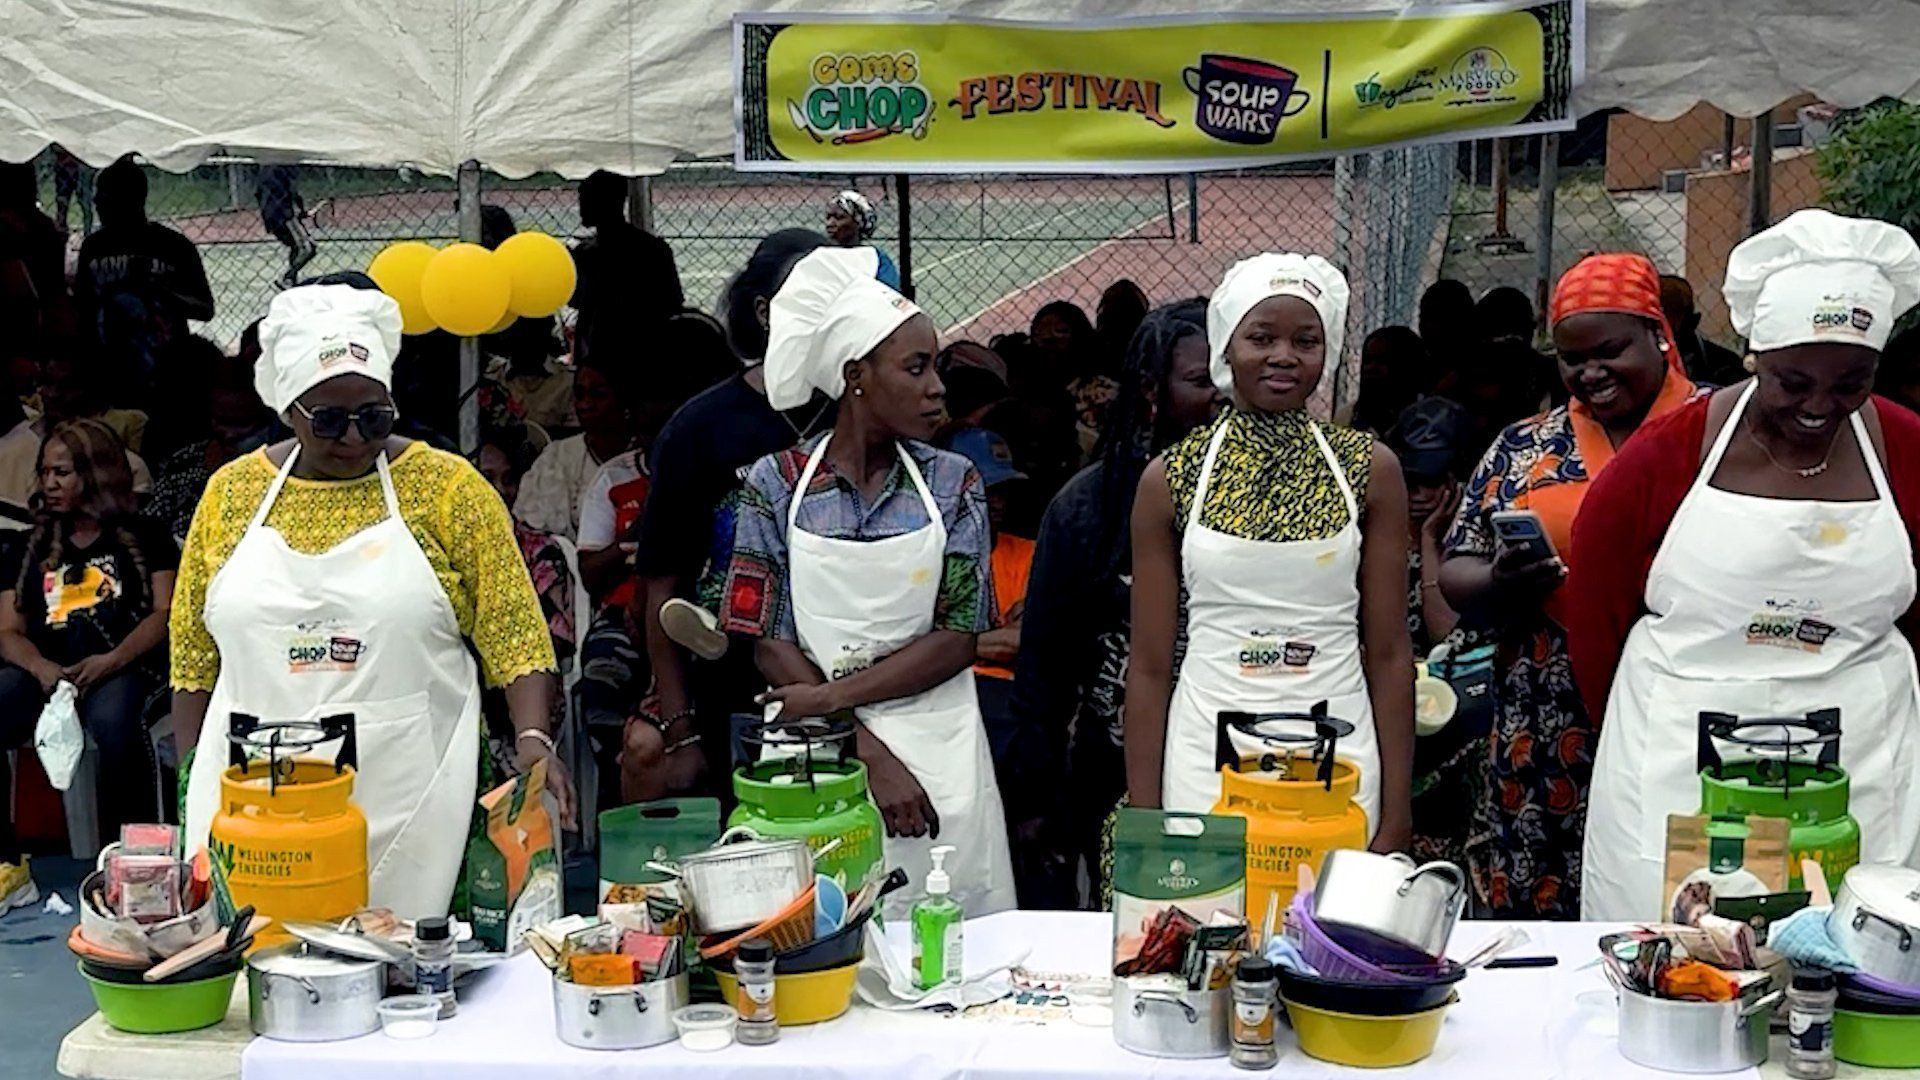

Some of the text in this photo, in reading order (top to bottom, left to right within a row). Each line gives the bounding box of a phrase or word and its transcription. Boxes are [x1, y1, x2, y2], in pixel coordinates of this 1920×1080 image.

[948, 72, 1176, 128] FESTIVAL
[1205, 80, 1280, 109] SOUP
[807, 86, 927, 130] CHOP
[1206, 104, 1275, 134] WARS
[1748, 623, 1794, 637] CHOP
[289, 647, 326, 660] CHOP
[1240, 651, 1280, 664] CHOP
[239, 848, 313, 862] WELLINGTON
[1246, 842, 1312, 858] ELLINGTON
[239, 862, 292, 876] ENERGIES
[1247, 858, 1290, 872] ERGIES
